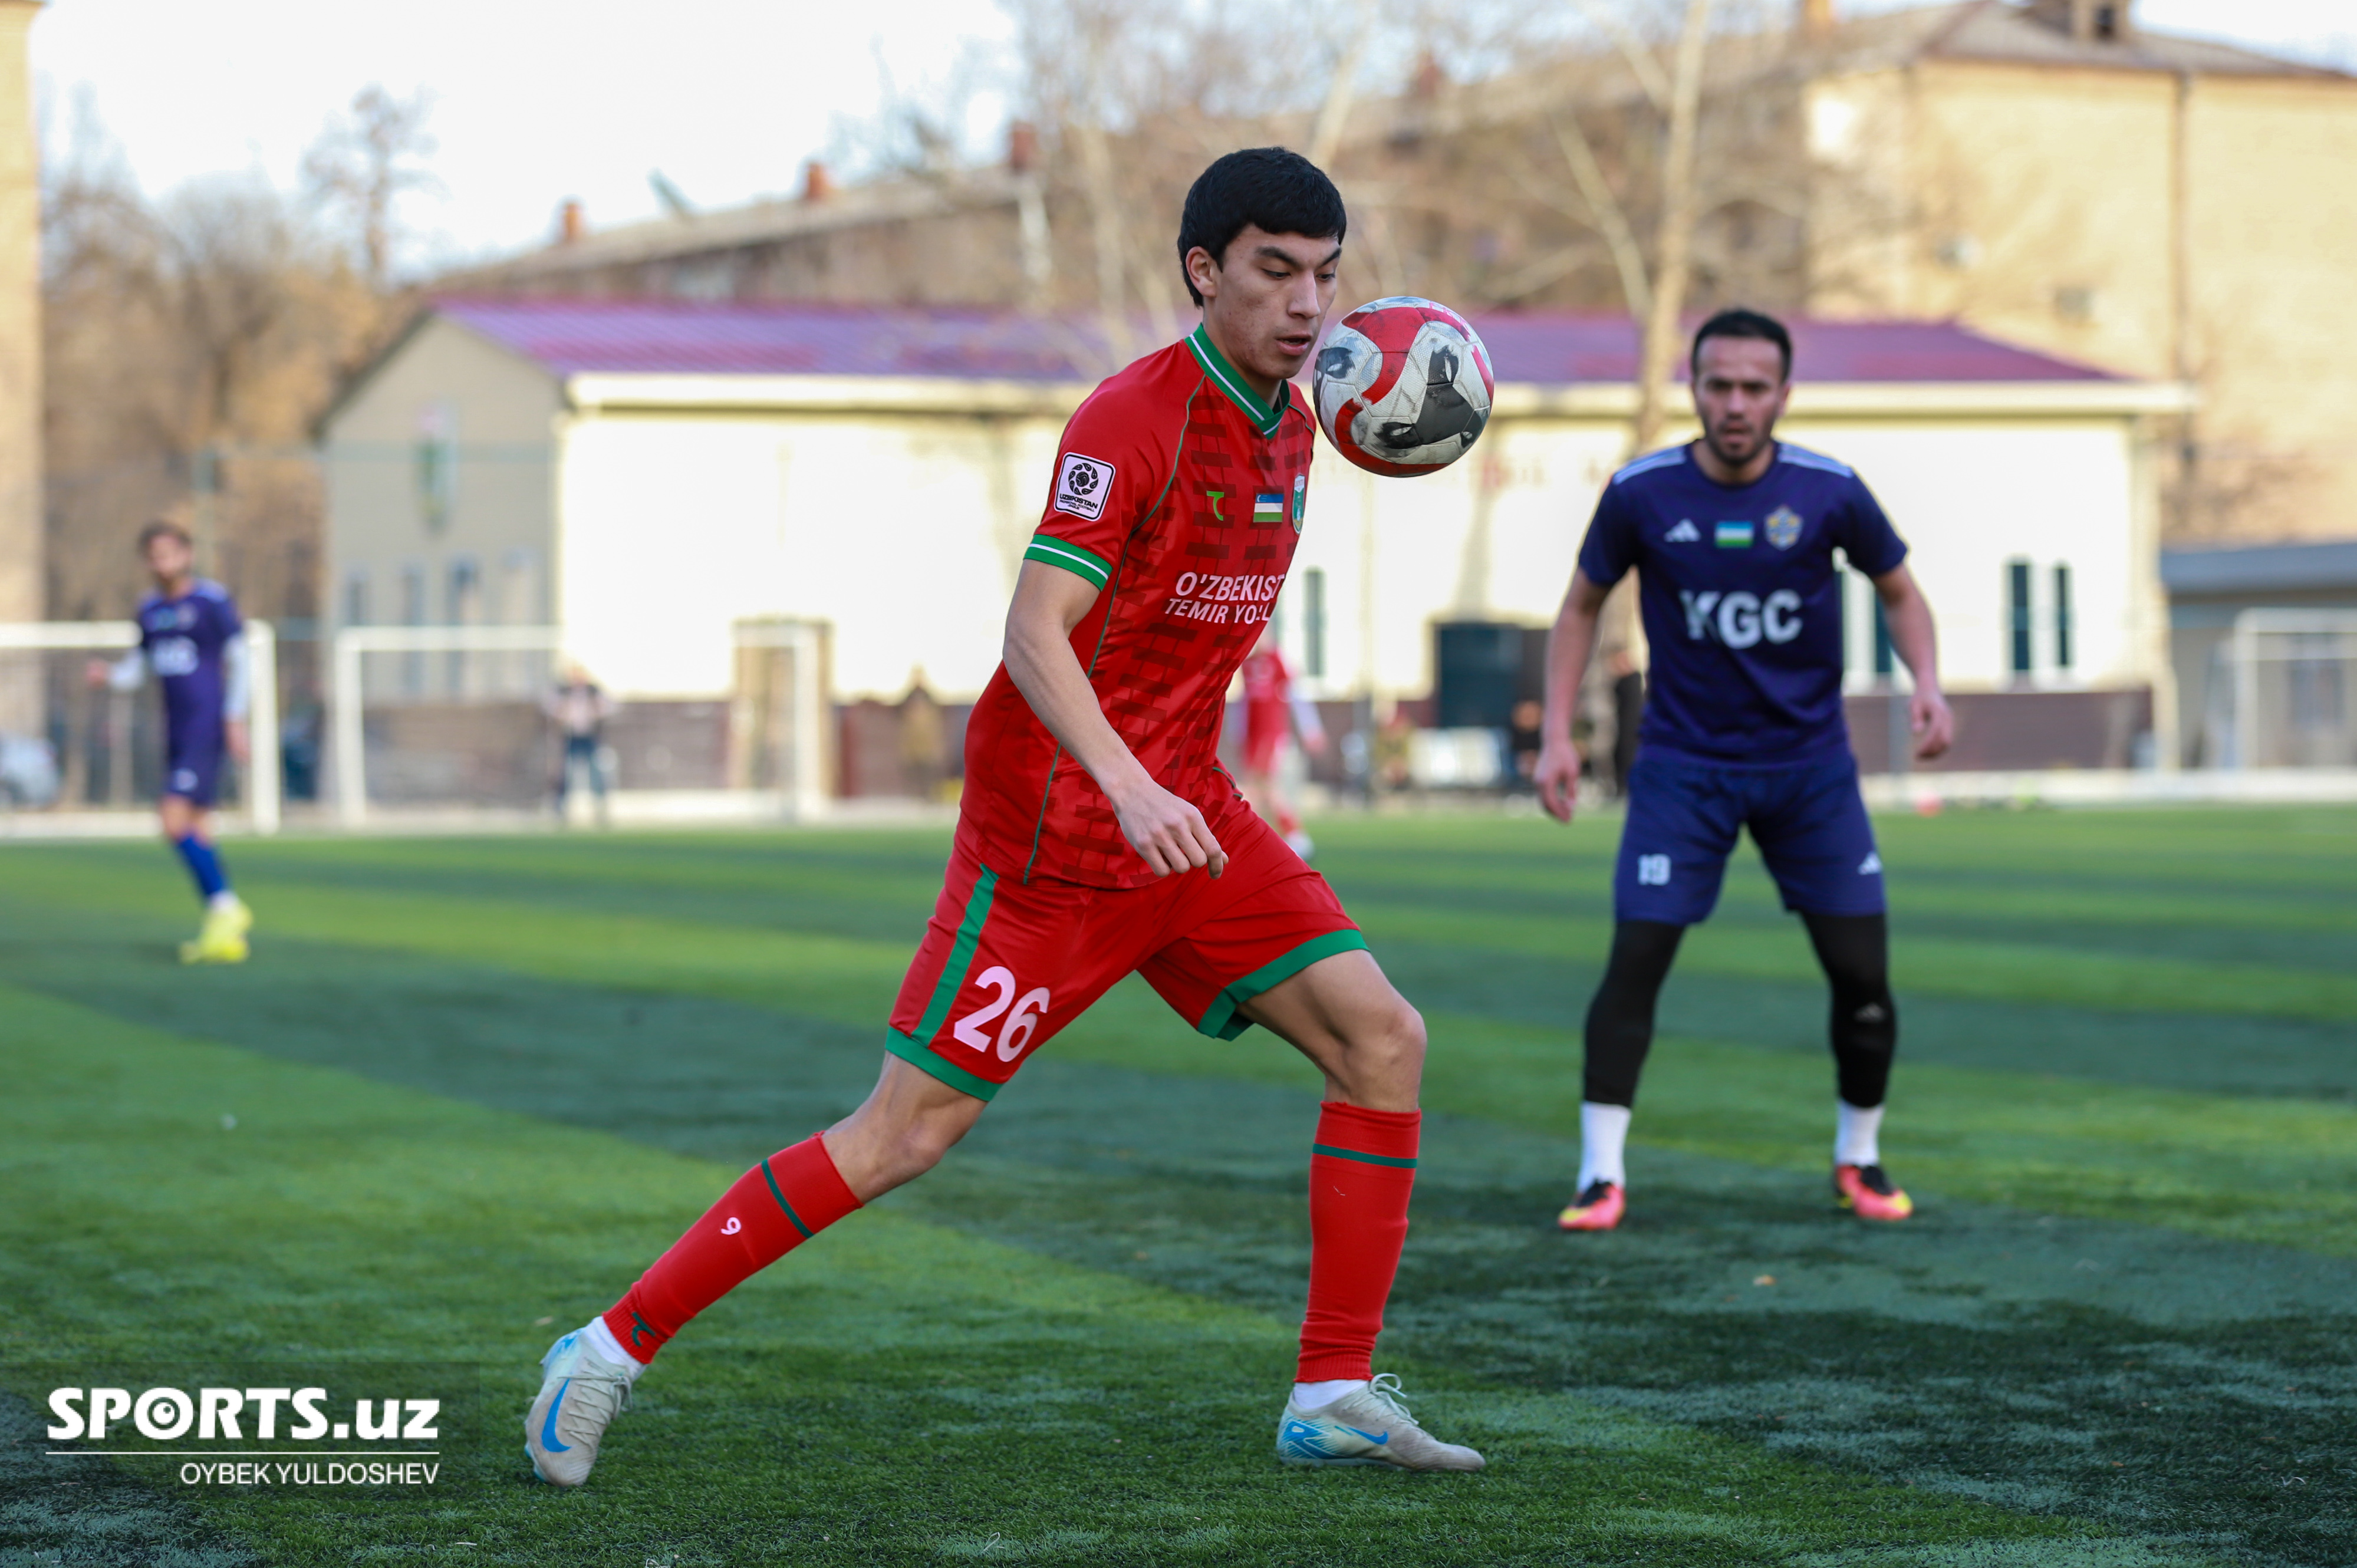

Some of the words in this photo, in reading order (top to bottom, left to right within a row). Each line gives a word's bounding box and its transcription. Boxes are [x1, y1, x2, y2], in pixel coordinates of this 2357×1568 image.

[1164, 598, 1229, 624] TEMIR
[1638, 853, 1671, 886] 19
[953, 965, 1050, 1062] 26
